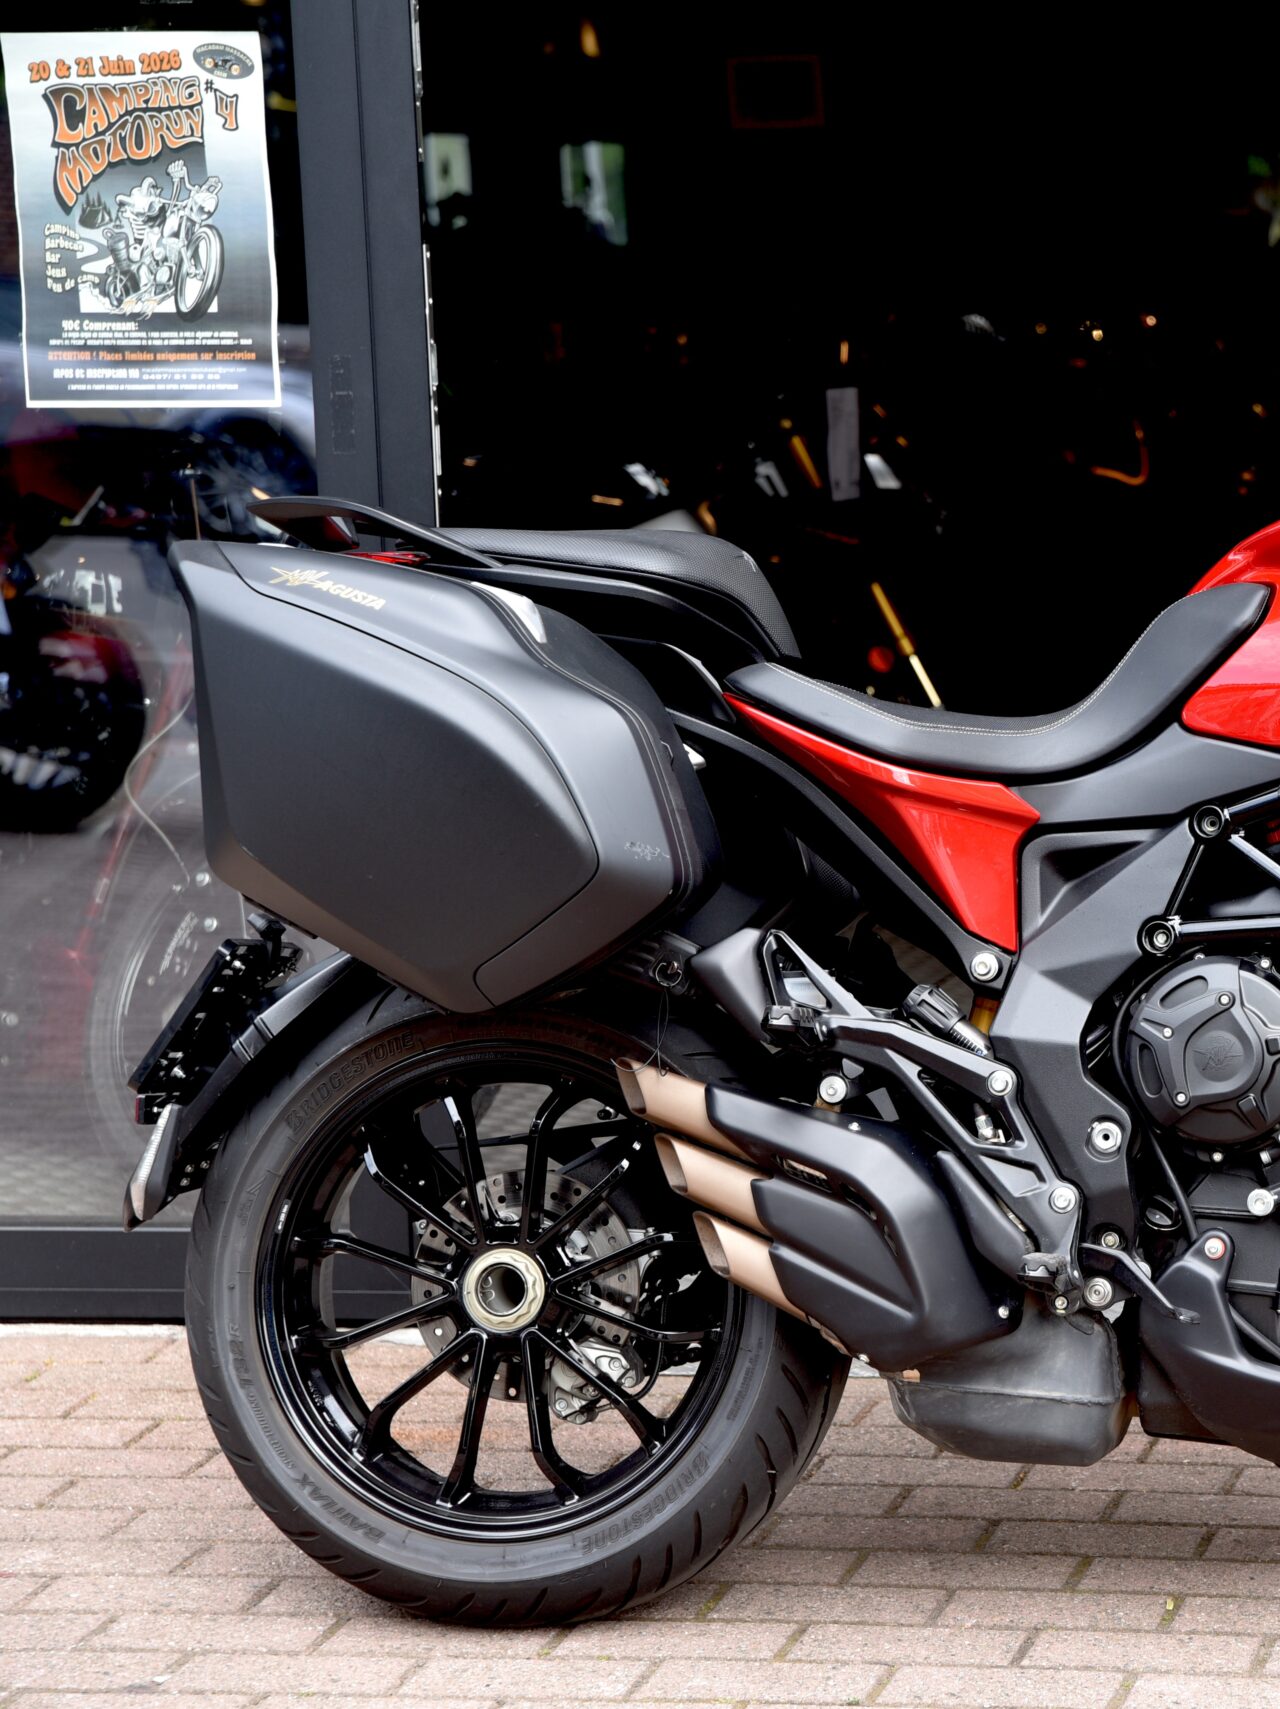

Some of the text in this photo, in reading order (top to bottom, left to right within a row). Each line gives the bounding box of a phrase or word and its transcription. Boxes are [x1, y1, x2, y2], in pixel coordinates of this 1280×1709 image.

[28, 48, 182, 83] 20 & 21 Juin 2026
[99, 350, 123, 361] Places
[285, 1031, 415, 1134] BRIDGESTONE
[581, 1450, 710, 1555] BRIDGESTONE
